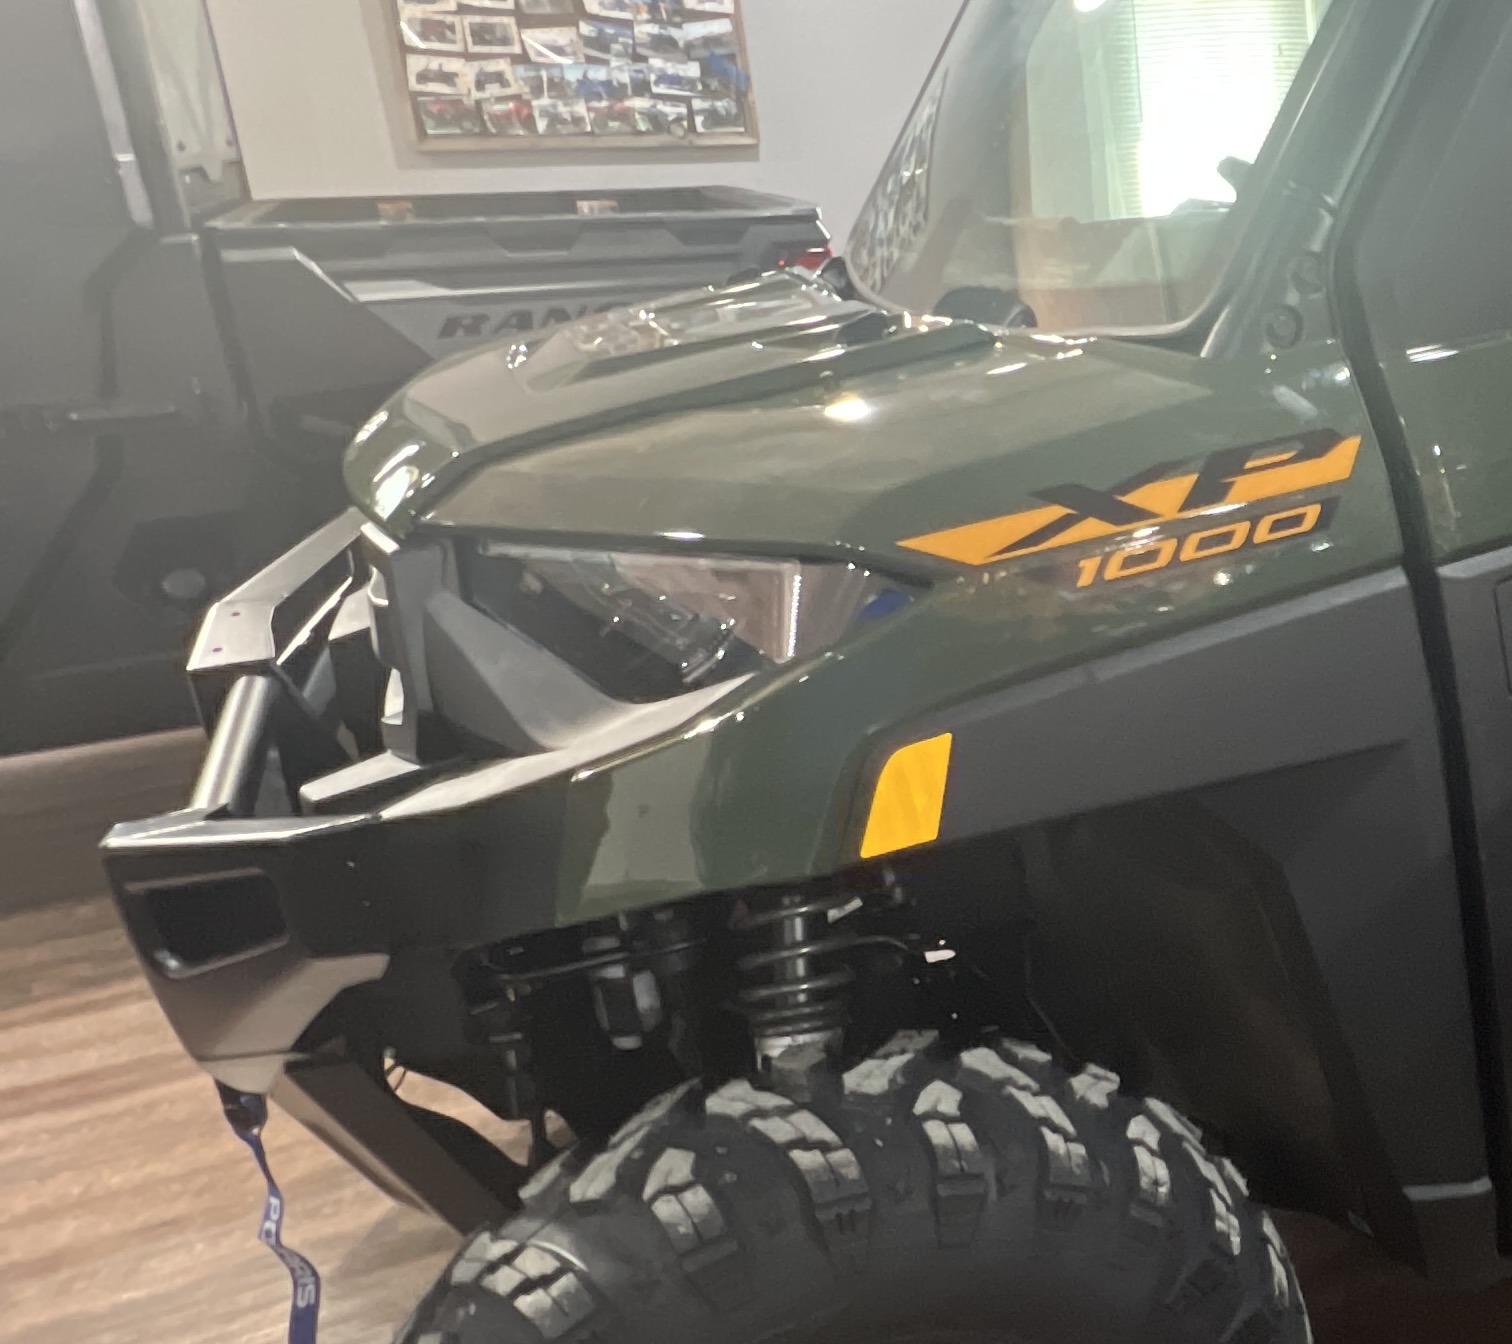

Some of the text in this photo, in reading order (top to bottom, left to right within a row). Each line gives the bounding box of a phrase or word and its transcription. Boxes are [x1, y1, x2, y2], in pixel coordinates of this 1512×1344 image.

[438, 302, 620, 340] RAN
[993, 427, 1348, 556] XP
[1076, 503, 1322, 589] 1000
